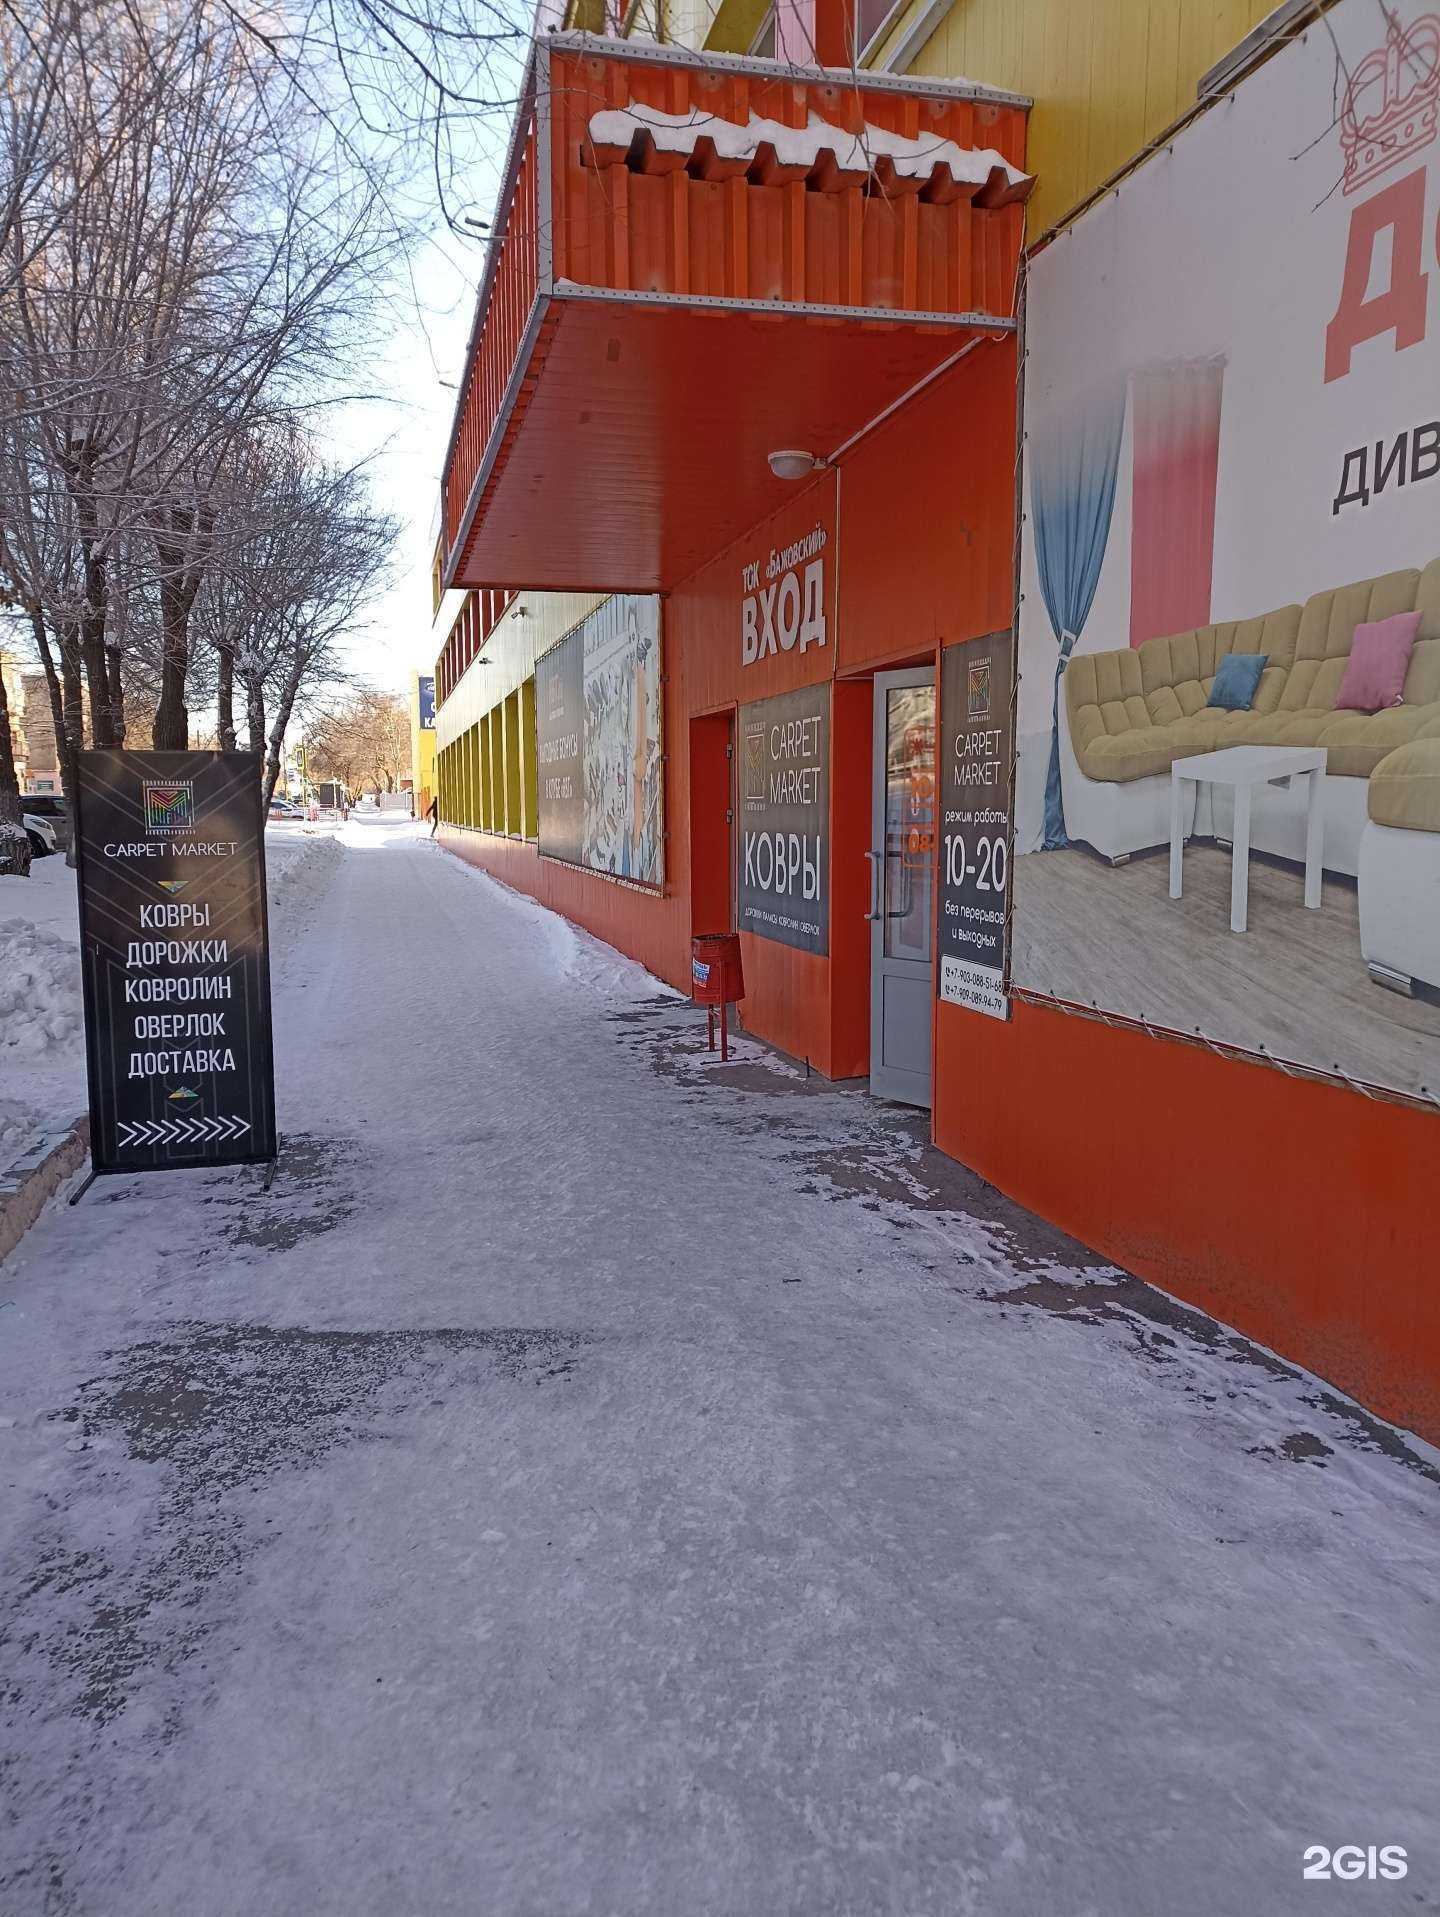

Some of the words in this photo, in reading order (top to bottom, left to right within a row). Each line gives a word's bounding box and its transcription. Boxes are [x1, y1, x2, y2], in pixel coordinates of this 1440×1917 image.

[1324, 165, 1440, 384] Д
[1332, 420, 1440, 516] ДИВ
[742, 559, 826, 666] ВХОД
[770, 716, 821, 760] CARPET
[955, 730, 1002, 757] CARPET
[770, 767, 820, 804] MARKET
[954, 762, 1001, 785] MARKET
[945, 809, 973, 825] режим
[104, 843, 167, 857] CARPET
[172, 842, 238, 856] MARKET
[745, 831, 820, 901] КОВРЫ
[944, 835, 1008, 892] 10-20
[140, 903, 210, 928] КОВРЫ
[945, 900, 959, 916] без
[960, 906, 1005, 925] перерывов
[951, 927, 957, 939] и
[958, 928, 996, 949] выходных
[126, 940, 228, 968] ДОРОЖКИ
[125, 976, 232, 1003] КОВРОЛИН
[134, 1012, 226, 1039] ОВЕРЛОК
[128, 1048, 236, 1079] ДОСТАВКА
